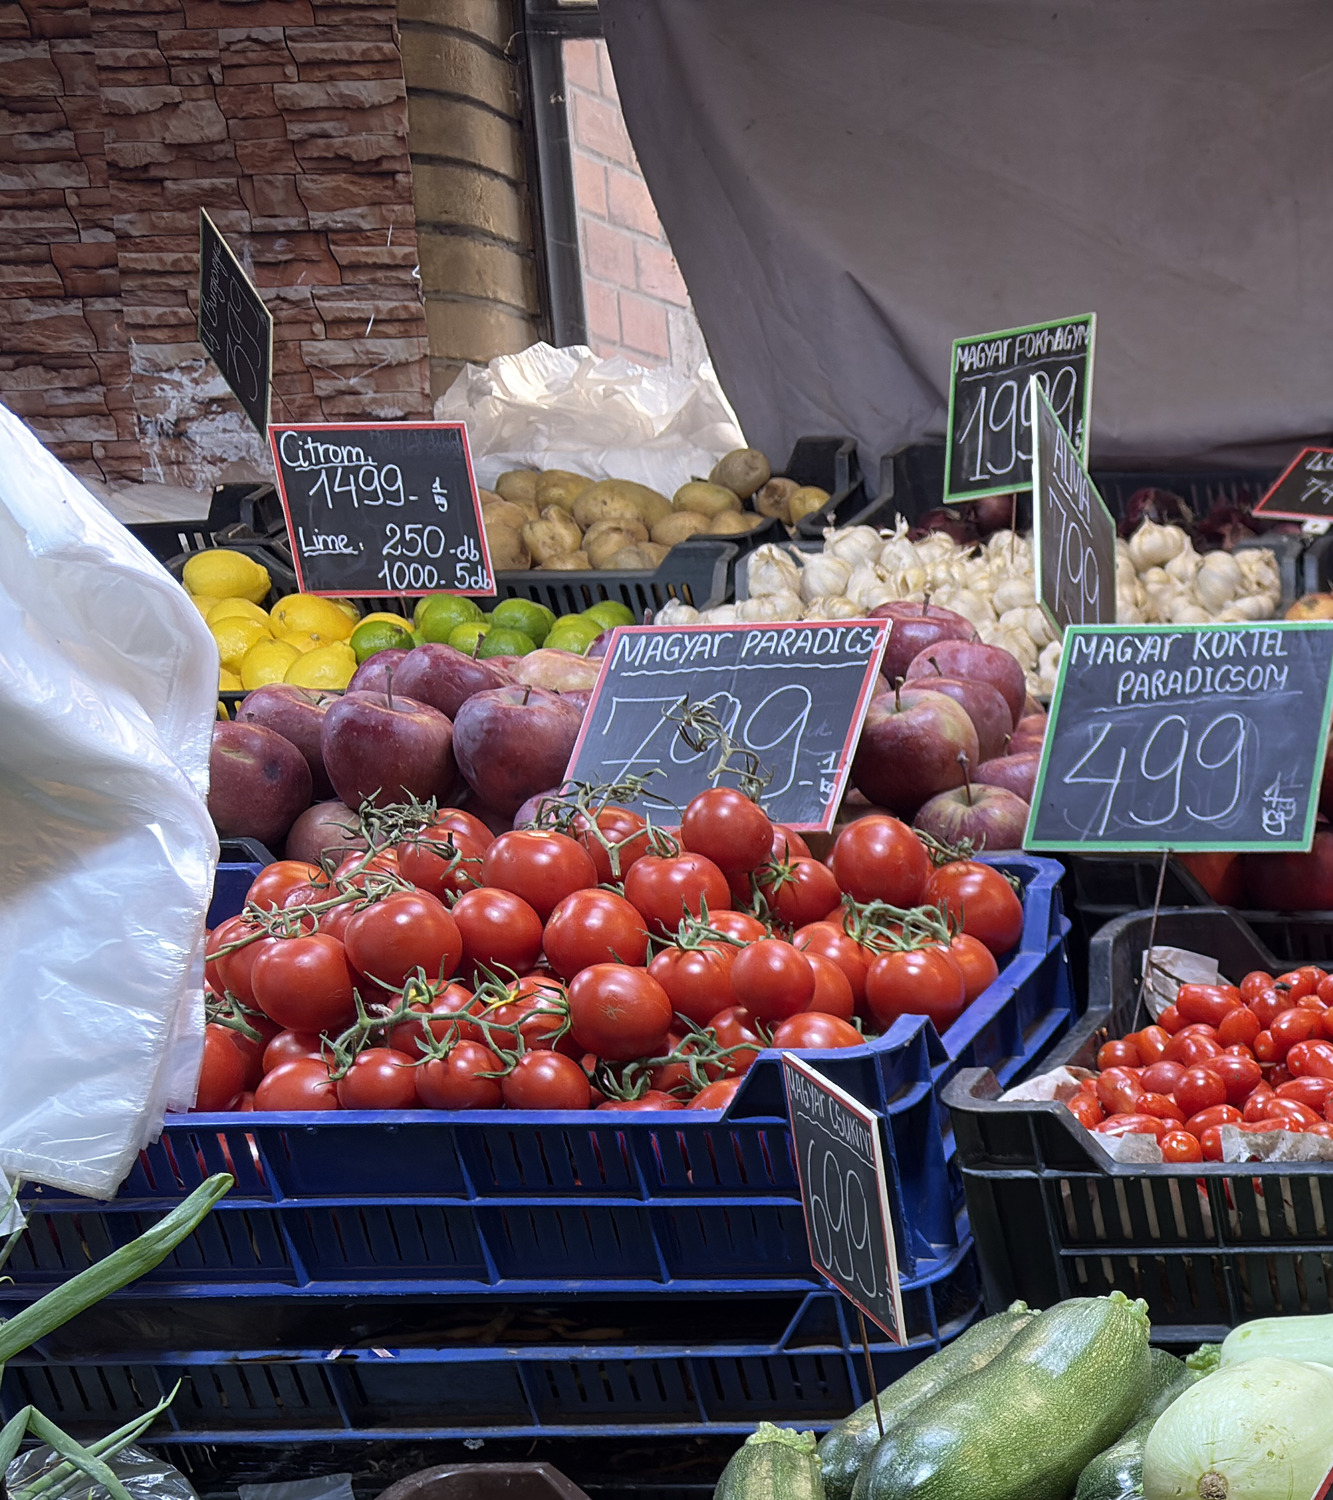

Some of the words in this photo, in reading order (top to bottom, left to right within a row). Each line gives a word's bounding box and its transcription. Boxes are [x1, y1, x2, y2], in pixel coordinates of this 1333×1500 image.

[226, 275, 261, 401] 399
[1054, 429, 1091, 523] ALMA
[1117, 664, 1288, 704] PARADICSOM
[1063, 711, 1247, 837] 499
